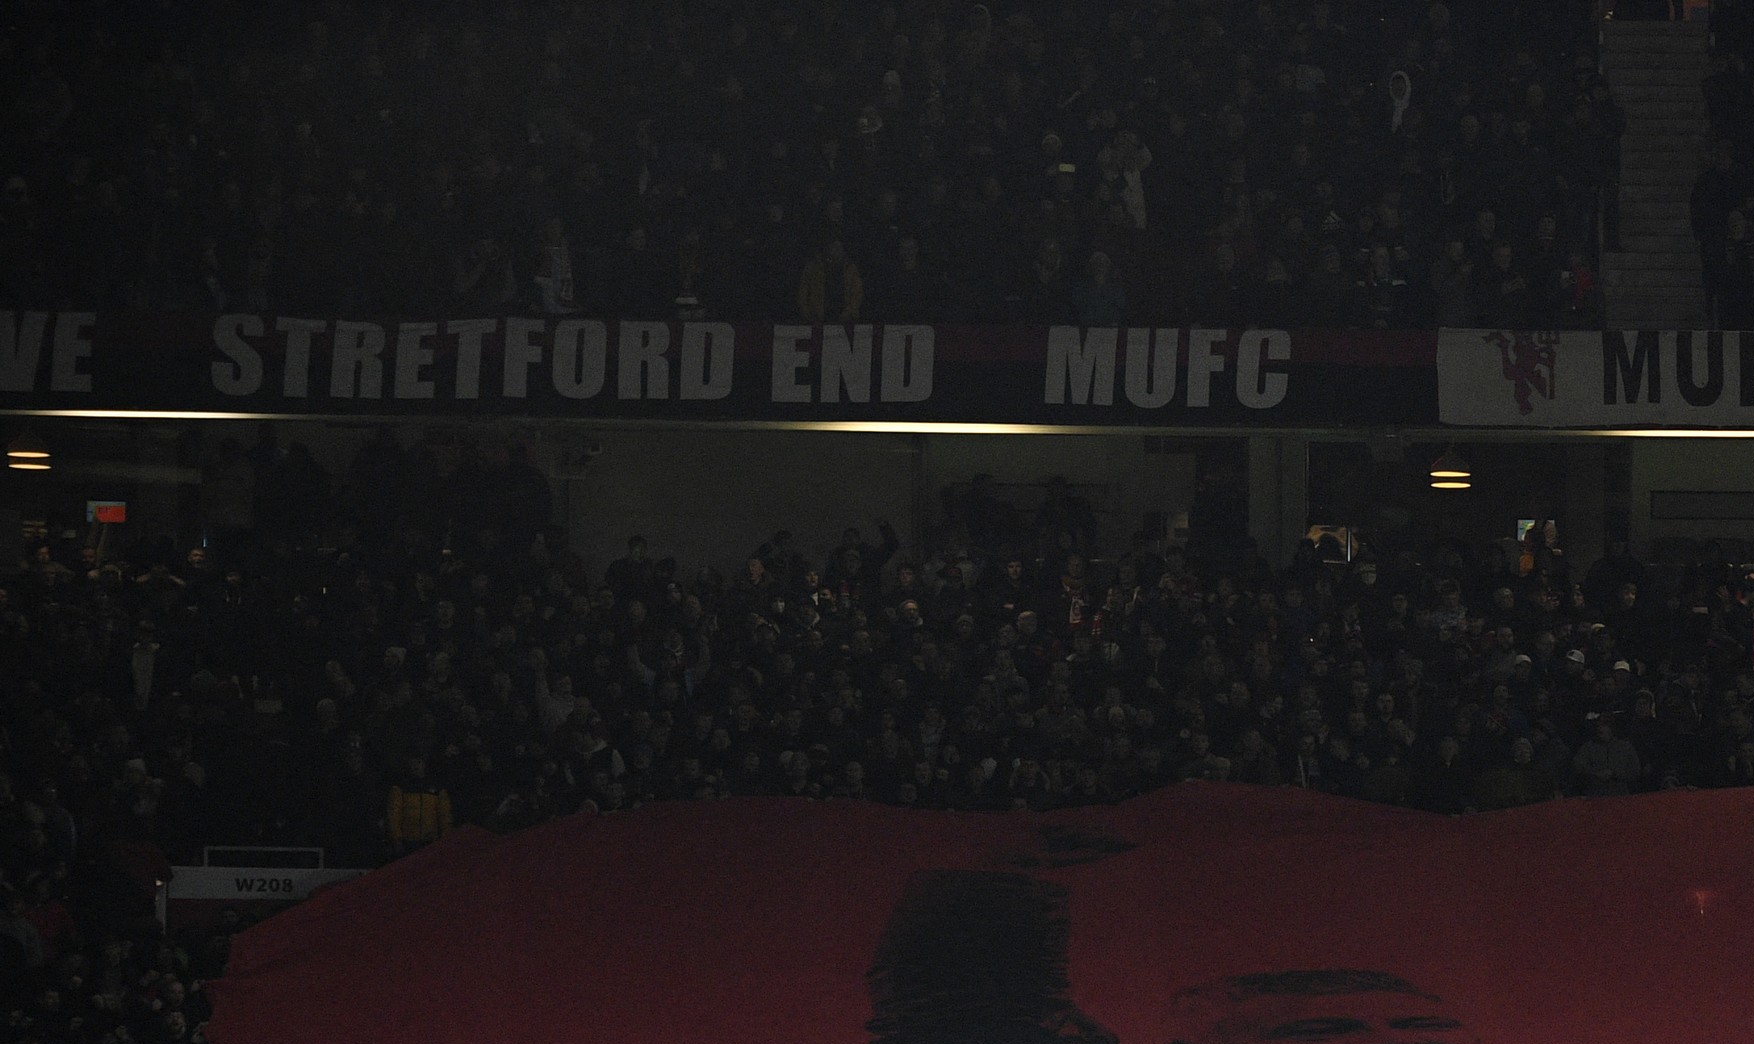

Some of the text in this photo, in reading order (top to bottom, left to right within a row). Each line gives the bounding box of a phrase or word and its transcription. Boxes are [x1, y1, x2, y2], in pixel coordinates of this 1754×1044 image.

[211, 312, 736, 401] STRETFORD
[771, 324, 935, 402] END
[1044, 325, 1292, 409] MUFC
[234, 877, 294, 893] W208
